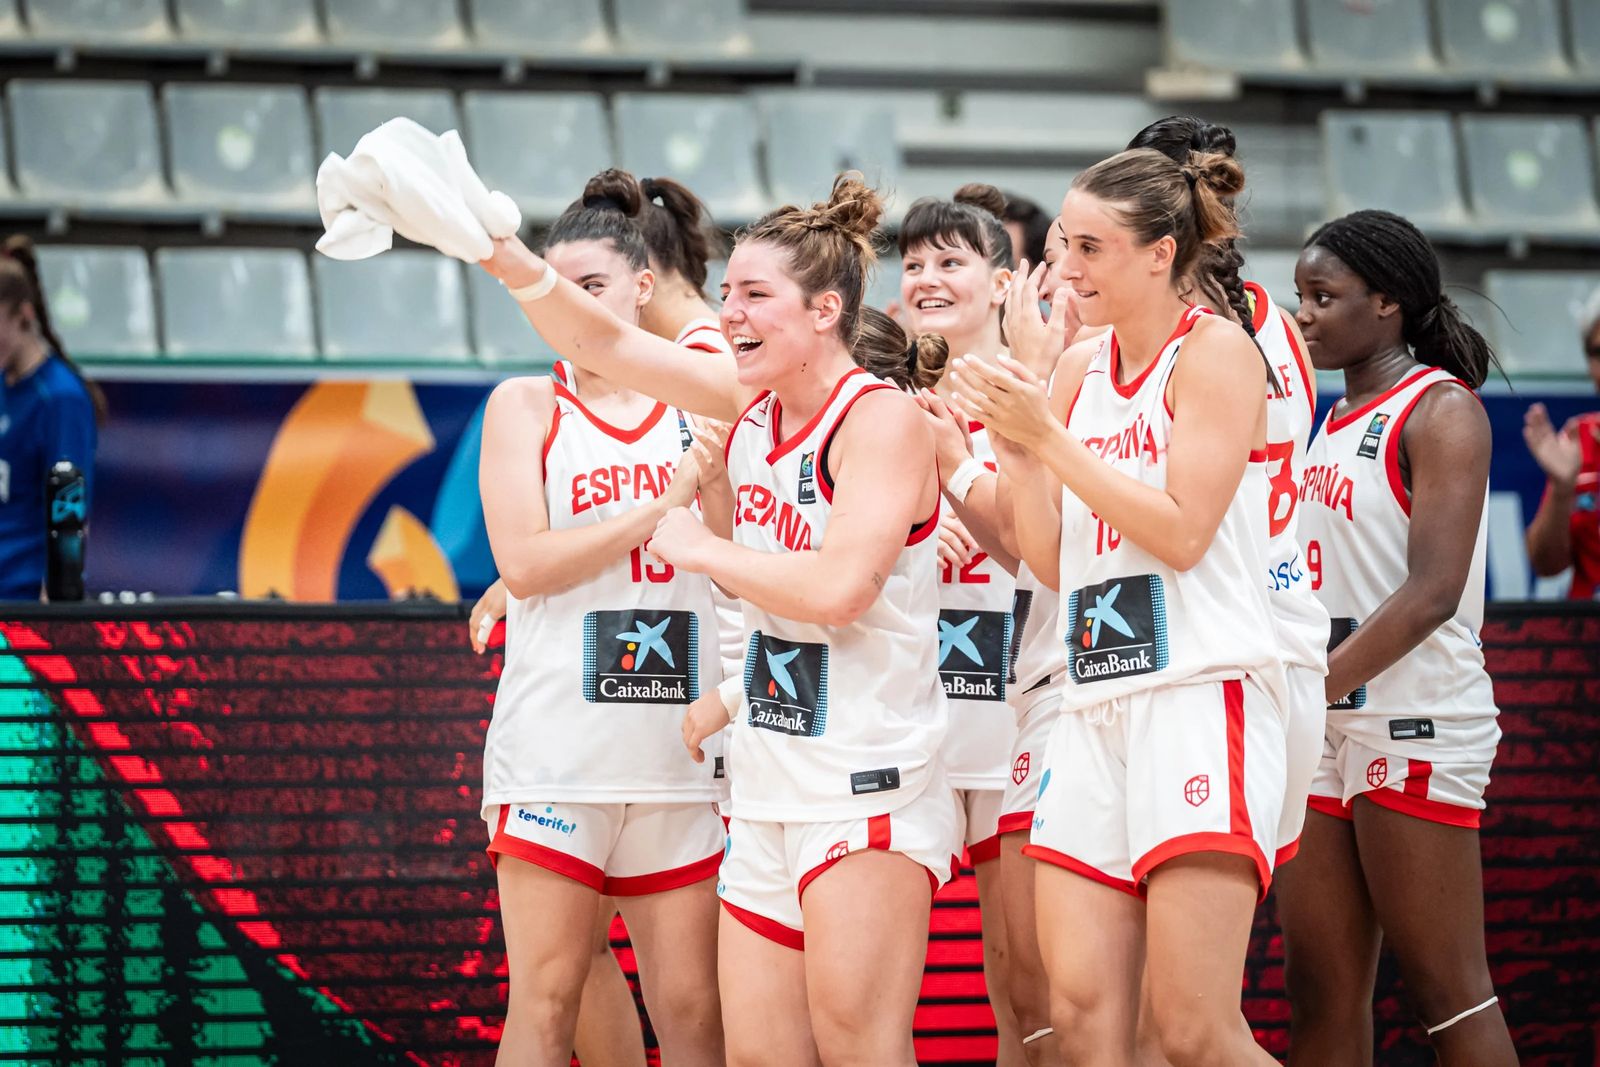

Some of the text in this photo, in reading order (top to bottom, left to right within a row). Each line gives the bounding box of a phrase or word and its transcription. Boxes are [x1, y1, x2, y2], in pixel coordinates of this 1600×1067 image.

[801, 481, 815, 492] FIB
[1307, 540, 1322, 590] 9
[1075, 649, 1152, 678] CaixaBank
[600, 678, 686, 700] CaixaBank
[944, 676, 998, 697] aBank
[1421, 723, 1430, 733] M
[885, 774, 892, 784] L
